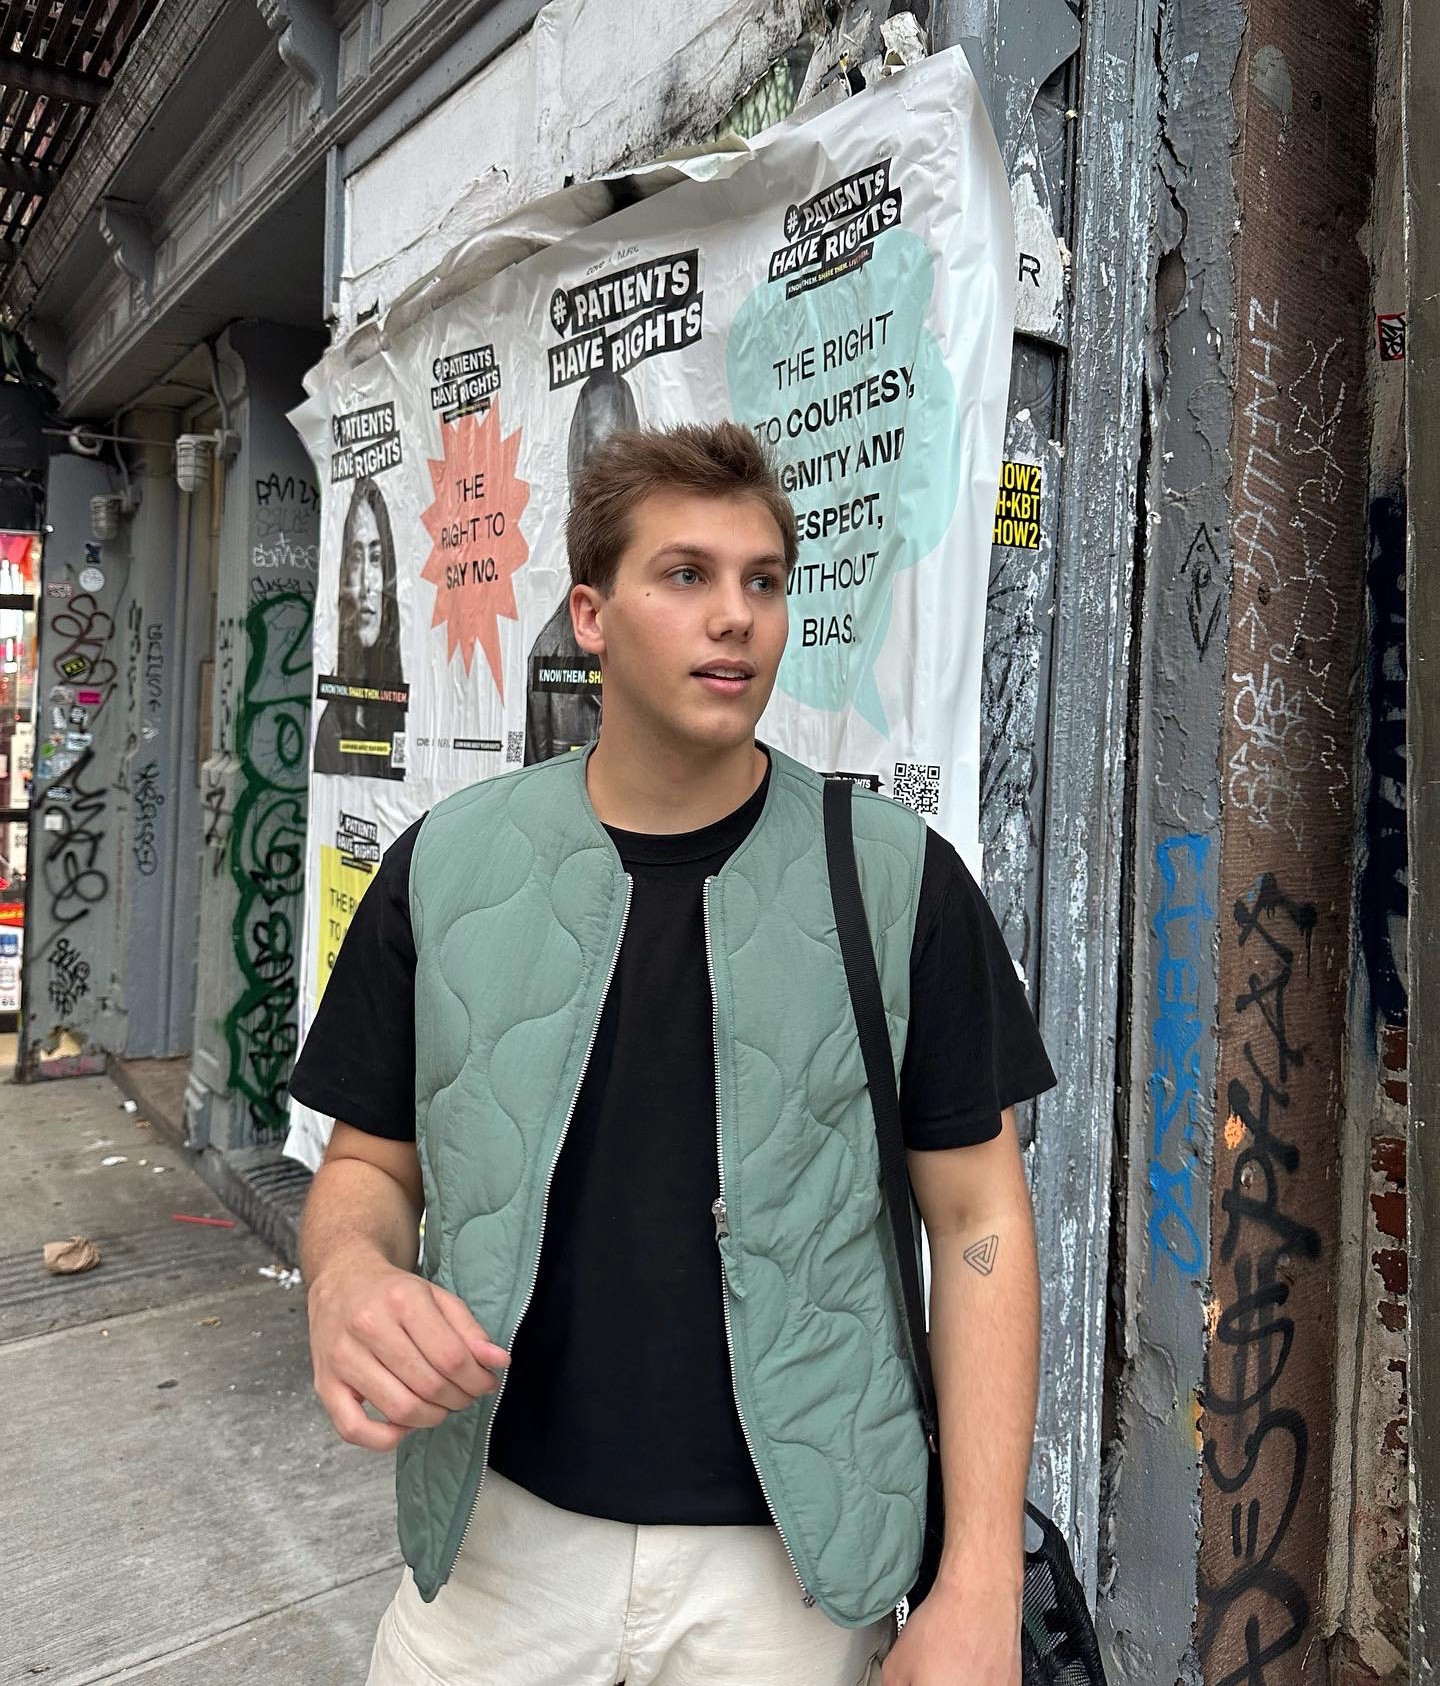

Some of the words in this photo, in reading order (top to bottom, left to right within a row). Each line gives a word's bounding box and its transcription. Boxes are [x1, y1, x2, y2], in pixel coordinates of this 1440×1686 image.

[772, 236, 821, 277] HAVE
[825, 198, 898, 262] RIGHTS
[1018, 252, 1041, 288] R
[552, 336, 604, 384] HAVE
[611, 302, 701, 373] RIGHTS
[773, 347, 816, 391] THE
[823, 310, 894, 373] RIGHT
[432, 383, 458, 407] HAVE
[460, 370, 499, 403] RIGHTS
[754, 416, 782, 449] TO
[787, 362, 915, 438] COURTESY,
[333, 452, 354, 479] HAVE
[355, 437, 401, 479] RIGHTS
[780, 446, 851, 494] GNITY
[856, 427, 905, 473] AND
[456, 473, 485, 503] THE
[441, 517, 481, 550] RIGHT
[485, 512, 505, 539] TO
[795, 493, 883, 541] ESPECT,
[992, 518, 1039, 549] HOW2
[446, 562, 468, 590] SAY
[472, 557, 499, 584] NO.
[802, 613, 856, 648] BIAS.
[539, 669, 561, 682] KNOW
[561, 670, 588, 684] THEM.
[329, 888, 348, 913] THE
[329, 919, 341, 942] TO
